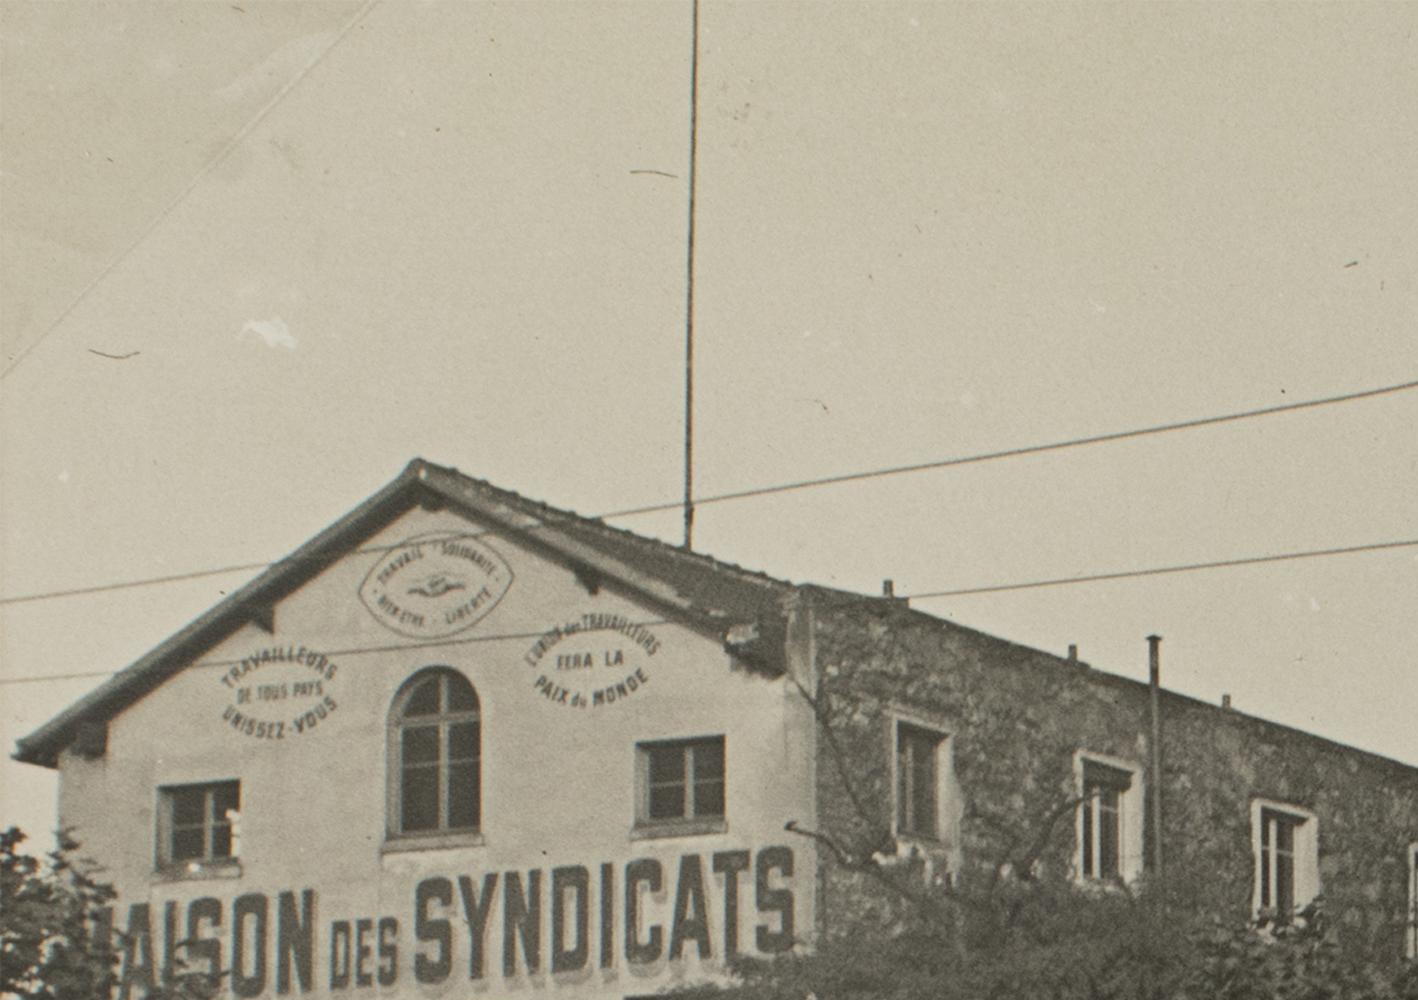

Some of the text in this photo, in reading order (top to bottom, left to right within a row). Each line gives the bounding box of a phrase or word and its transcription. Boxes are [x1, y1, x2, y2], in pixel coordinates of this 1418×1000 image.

[377, 544, 424, 586] TRAVAIL
[221, 645, 338, 689] TRAVAILLEURS
[556, 649, 624, 671] FERA LA
[293, 680, 323, 697] PAYS
[533, 674, 570, 706] PAIX
[592, 667, 650, 708] MONDE
[330, 917, 398, 992] DES
[413, 845, 796, 986] SYNDICATS
